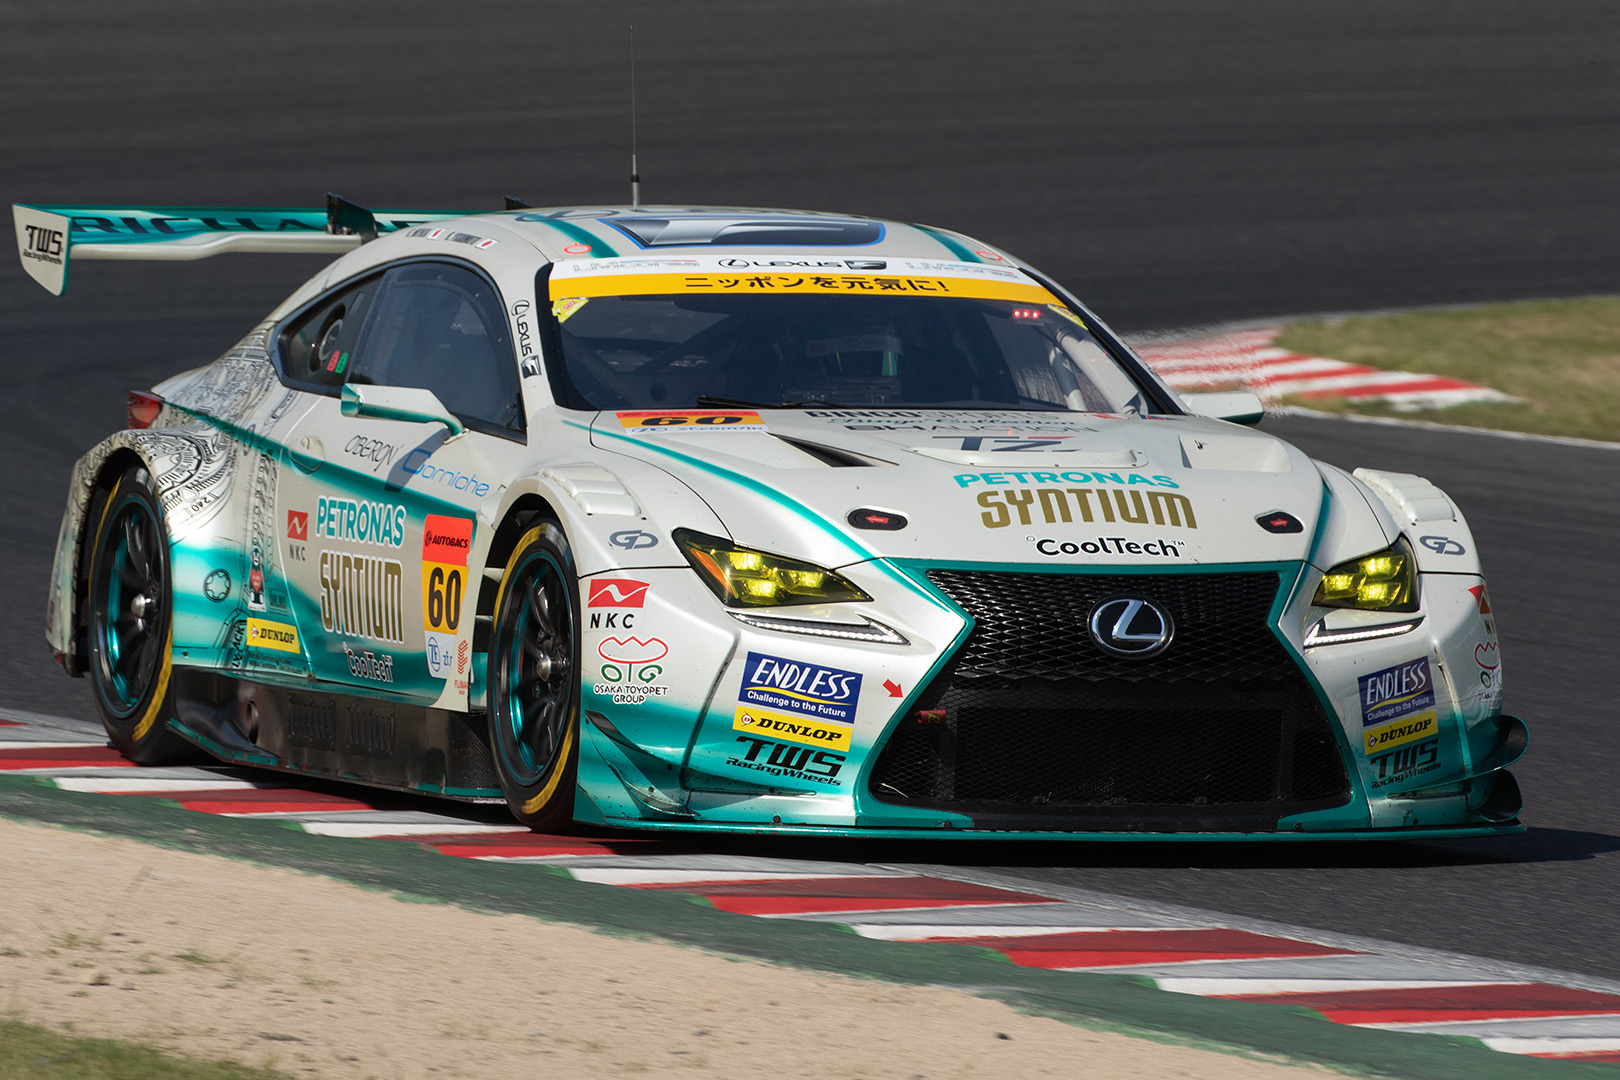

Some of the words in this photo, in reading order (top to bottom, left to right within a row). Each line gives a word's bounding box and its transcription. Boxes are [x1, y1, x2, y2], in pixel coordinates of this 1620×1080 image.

[25, 224, 63, 256] TWS
[516, 314, 533, 357] LEXUS
[640, 415, 744, 427] 60
[344, 434, 400, 472] OBERON
[953, 472, 1181, 488] PETRONAS
[316, 495, 406, 548] PETRONAS
[976, 489, 1198, 529] SYNTIUM
[289, 544, 306, 561] NKC
[431, 534, 469, 549] AUTOBACS
[319, 551, 405, 643] SYNTIUM
[428, 566, 461, 630] 60
[589, 613, 635, 629] NKC
[260, 628, 295, 644] DUNLOP
[594, 684, 623, 694] OSAKA
[625, 685, 668, 696] TOYOPET
[750, 657, 856, 700] ENDLESS
[1366, 661, 1426, 706] ENDLESS
[613, 694, 646, 704] GROUP
[747, 690, 790, 707] Challenge
[791, 699, 800, 708] to
[802, 702, 816, 712] the
[818, 705, 846, 717] Future
[1367, 708, 1395, 721] Challenge
[1395, 703, 1402, 712] to
[1402, 702, 1411, 711] the
[1412, 696, 1430, 708] Future
[756, 717, 843, 742] DUNLOP
[1379, 718, 1432, 744] DUNLOP
[736, 735, 847, 778] TWS
[1370, 738, 1439, 779] TWS
[726, 757, 843, 786] RacingWheels
[1371, 762, 1441, 789] RacingWheels
